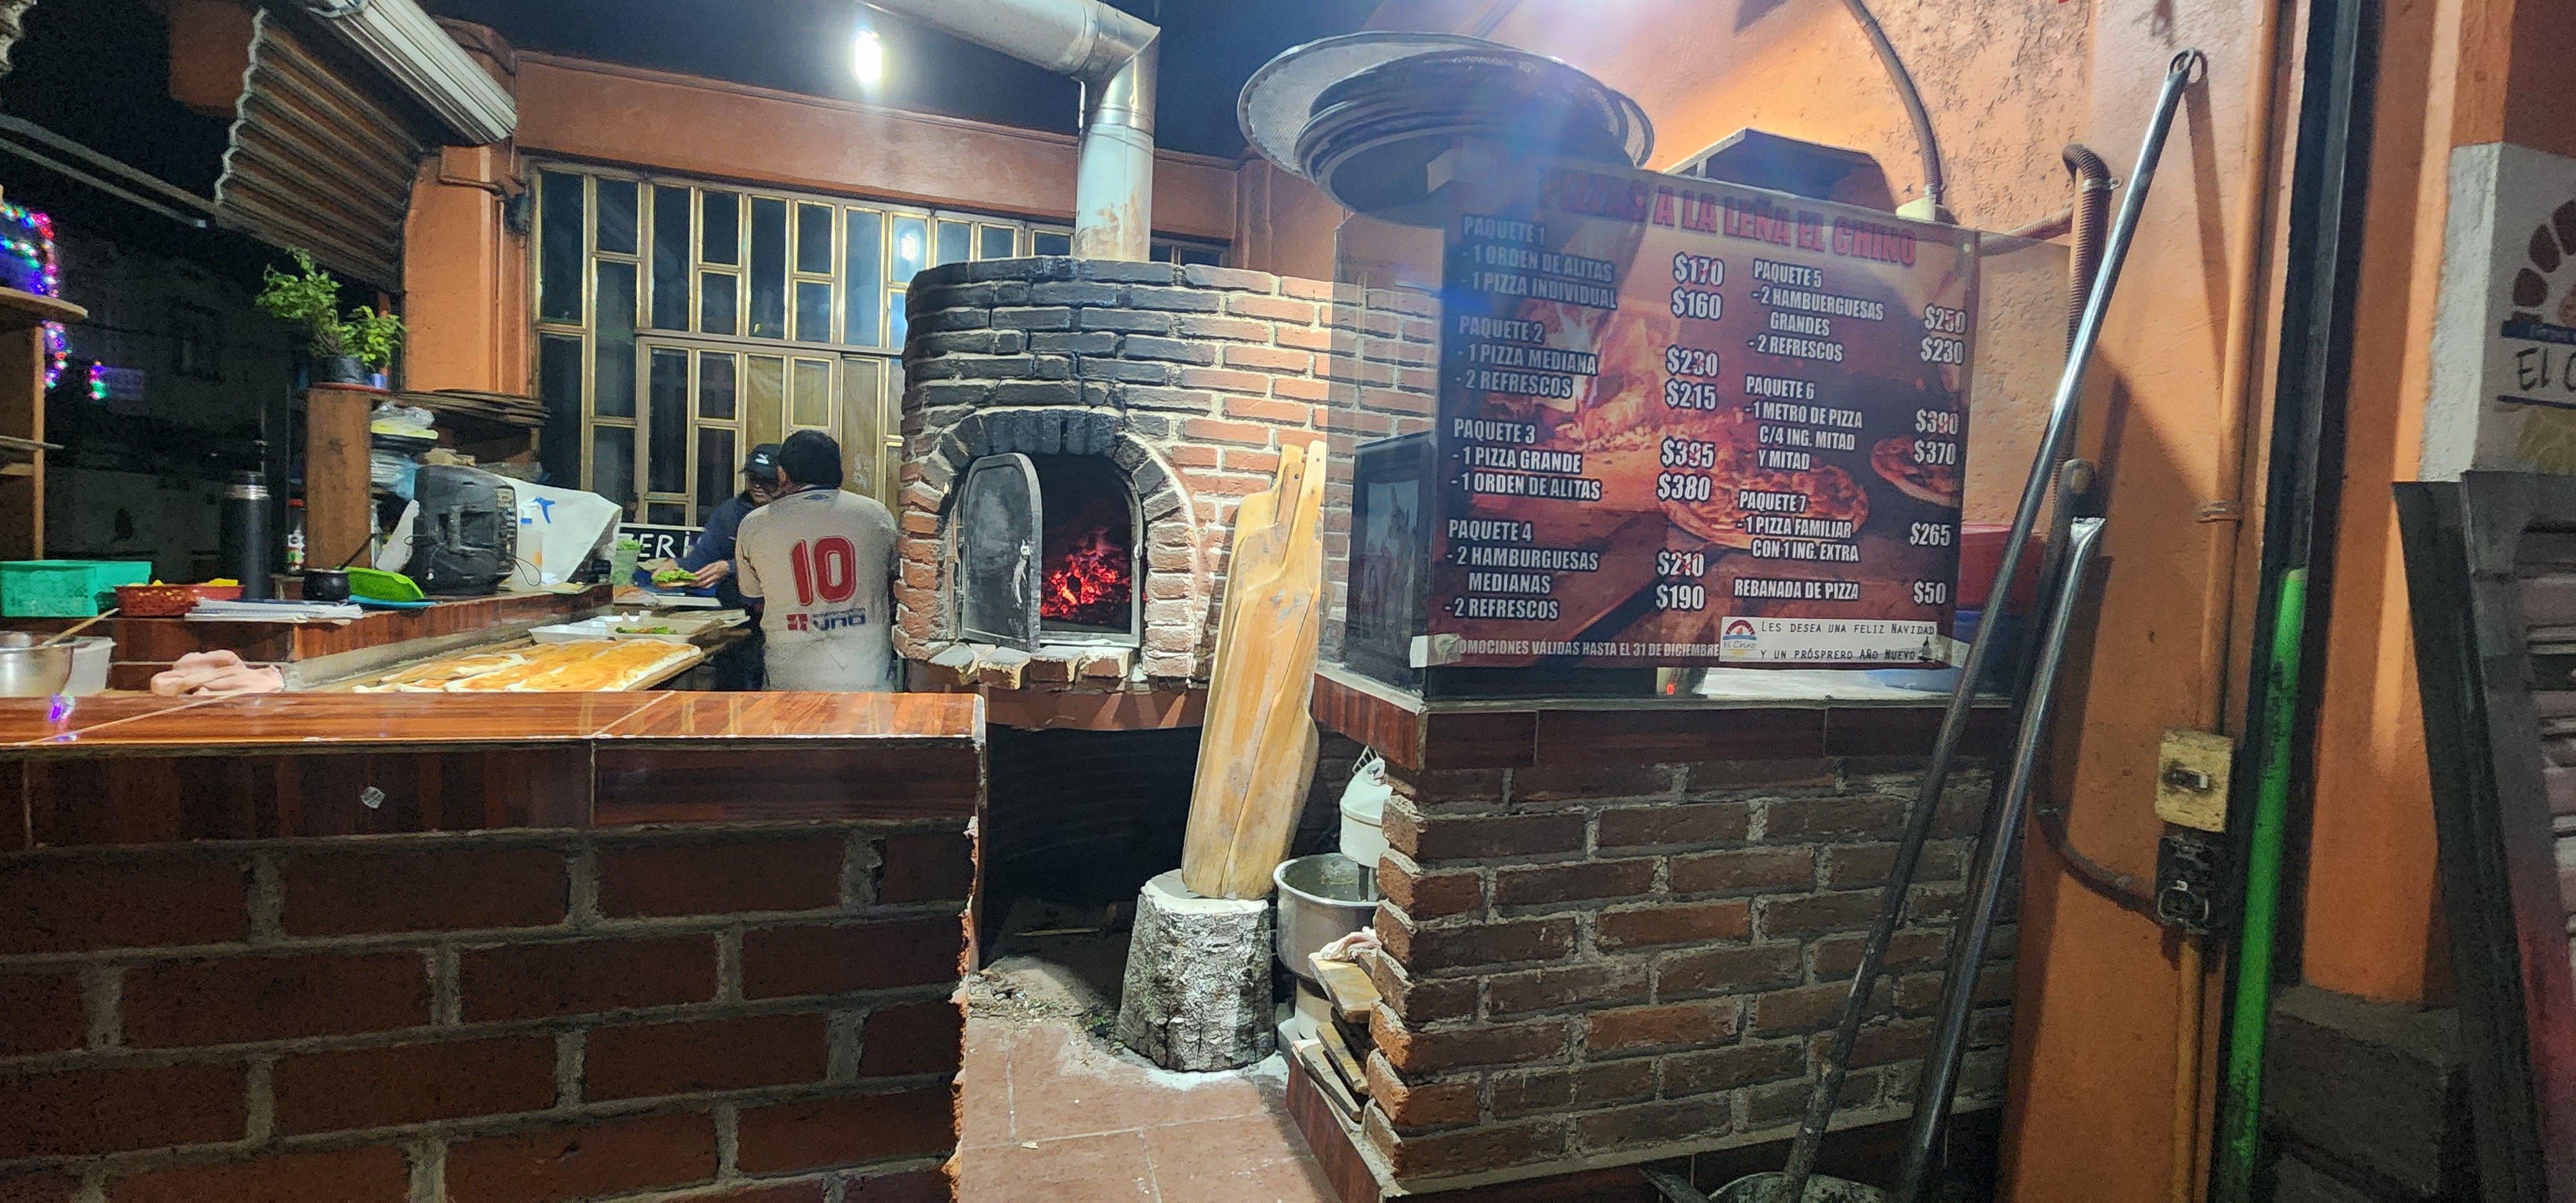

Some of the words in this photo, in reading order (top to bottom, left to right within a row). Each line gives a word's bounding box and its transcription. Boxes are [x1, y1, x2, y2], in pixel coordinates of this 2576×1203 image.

[1463, 215, 1535, 243] PAQUETE
[1538, 226, 1546, 246] 1
[1542, 169, 1648, 222] PIZZAS
[1653, 184, 1674, 226] A
[1682, 189, 1718, 233] LA
[1724, 196, 1791, 246] LEÑA
[1797, 211, 1825, 252] EL
[1833, 216, 1916, 266] CHINO
[1473, 244, 1481, 263] 1
[1486, 245, 1538, 269] ORDEN
[1542, 253, 1560, 274] DE
[1564, 257, 1612, 282] ALITAS
[1674, 254, 1723, 286] $170
[1754, 260, 1812, 287] PAQUETE
[1814, 270, 1822, 288] 5
[1472, 271, 1479, 289] 1
[1484, 272, 1527, 295] PIZZA
[1532, 278, 1616, 308] INDIVIDUAL
[1672, 288, 1721, 319] $160
[1761, 286, 1770, 304] 2
[1773, 289, 1884, 321] HAMBUERGUESAS
[1459, 316, 1529, 341] PAQUETE
[1533, 323, 1544, 342] 2
[1771, 312, 1830, 336] GRANDES
[1469, 343, 1476, 361] 1
[1480, 344, 1524, 366] PIZZA
[1528, 349, 1596, 374] MEDIANA
[1757, 335, 1766, 352] 2
[1770, 336, 1843, 361] REFRESCOS
[1921, 336, 1964, 364] $230
[1465, 370, 1475, 388] 2
[1480, 370, 1571, 397] REFRESCOS
[1666, 380, 1716, 410] $215
[1746, 375, 1803, 398] PAQUETE
[1806, 383, 1815, 400] 6
[1754, 401, 1759, 418] 1
[1763, 403, 1806, 422] METRO
[1810, 407, 1826, 424] DE
[1829, 410, 1862, 428] PIZZA
[1454, 418, 1521, 442] PAQUETE
[1525, 425, 1535, 444] 3
[1760, 426, 1784, 444] C/4
[1787, 428, 1812, 446] ING.
[1815, 431, 1855, 450] MITAD
[1463, 446, 1470, 464] 1
[1475, 447, 1517, 468] PIZZA
[1520, 450, 1582, 473] GRANDE
[1662, 439, 1714, 468] $395
[1758, 450, 1766, 467] Y
[1769, 451, 1810, 470] MITAD
[1914, 439, 1956, 465] $370
[1462, 472, 1469, 490] 1
[1474, 473, 1524, 494] ORDEN
[1529, 476, 1547, 497] DE
[1550, 478, 1600, 500] ALITAS
[1658, 473, 1711, 501] $380
[1739, 491, 1797, 512] PAQUETE
[1800, 496, 1807, 513] 7
[1449, 519, 1519, 541] PAQUETE
[1522, 523, 1532, 542] 4
[1746, 516, 1752, 533] 1
[1756, 516, 1792, 535] PIZZA
[1795, 519, 1852, 538] FAMILIAR
[1910, 522, 1951, 546] $265
[1457, 546, 1467, 565] 2
[1472, 547, 1600, 570] HAMBURGUESAS
[1657, 551, 1704, 577] $210
[1752, 540, 1780, 558] CON
[1783, 542, 1789, 558] 1
[1792, 542, 1817, 559] ING.
[1820, 544, 1859, 562] EXTRA
[791, 535, 857, 606] 10
[1468, 573, 1551, 594] MEDIANAS
[1656, 583, 1705, 610] $190
[1734, 579, 1801, 598] REBANADA
[1805, 582, 1821, 599] DE
[1825, 583, 1859, 600] PIZZA
[1914, 581, 1946, 604] $50
[1454, 598, 1464, 616] 2
[1469, 599, 1558, 619] REFRESCOS
[1761, 621, 1782, 632] LES
[1790, 623, 1821, 633] DESEA
[1828, 624, 1846, 633] UNA
[1854, 624, 1885, 634] FELIZ
[1891, 623, 1934, 635] NAVIDAD
[1455, 639, 1529, 654] OMOCIONES
[1532, 638, 1580, 655] VÁLIDAS
[1582, 642, 1617, 656] HASTA
[1620, 642, 1631, 656] EL
[1633, 643, 1645, 656] 31
[1648, 643, 1662, 656] DE
[1664, 643, 1719, 657] DICIEMBRE
[1761, 650, 1766, 659] Y
[1774, 650, 1786, 659] UN
